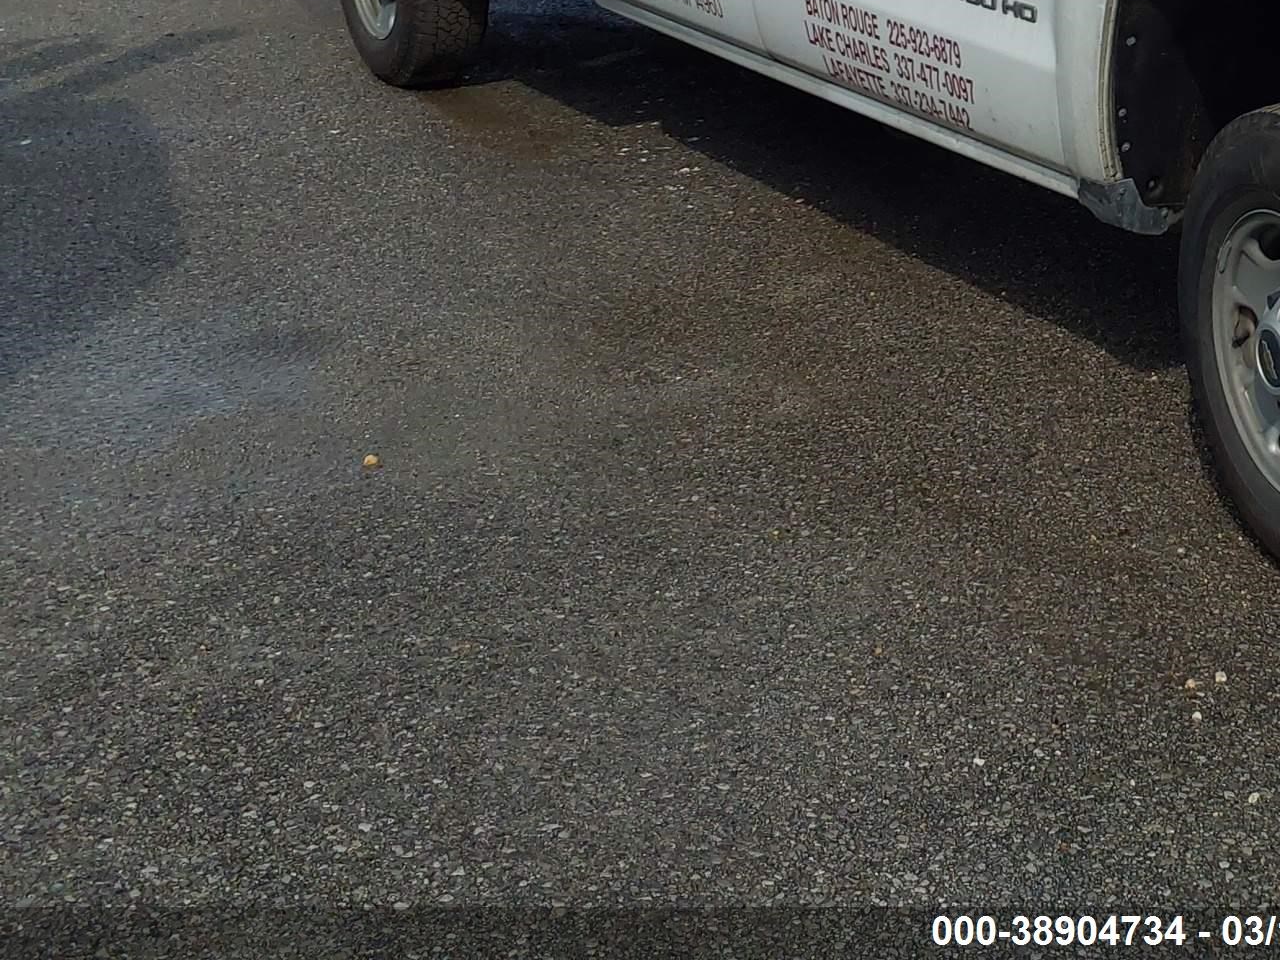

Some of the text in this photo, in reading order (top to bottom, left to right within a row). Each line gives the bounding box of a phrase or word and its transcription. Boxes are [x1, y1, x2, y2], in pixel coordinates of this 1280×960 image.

[804, 20, 975, 105] LAKE CHARLES 337-477-0097
[840, 3, 881, 40] ROUGE
[886, 19, 961, 69] 225-923-6879
[822, 54, 890, 98] LAFAYETTE
